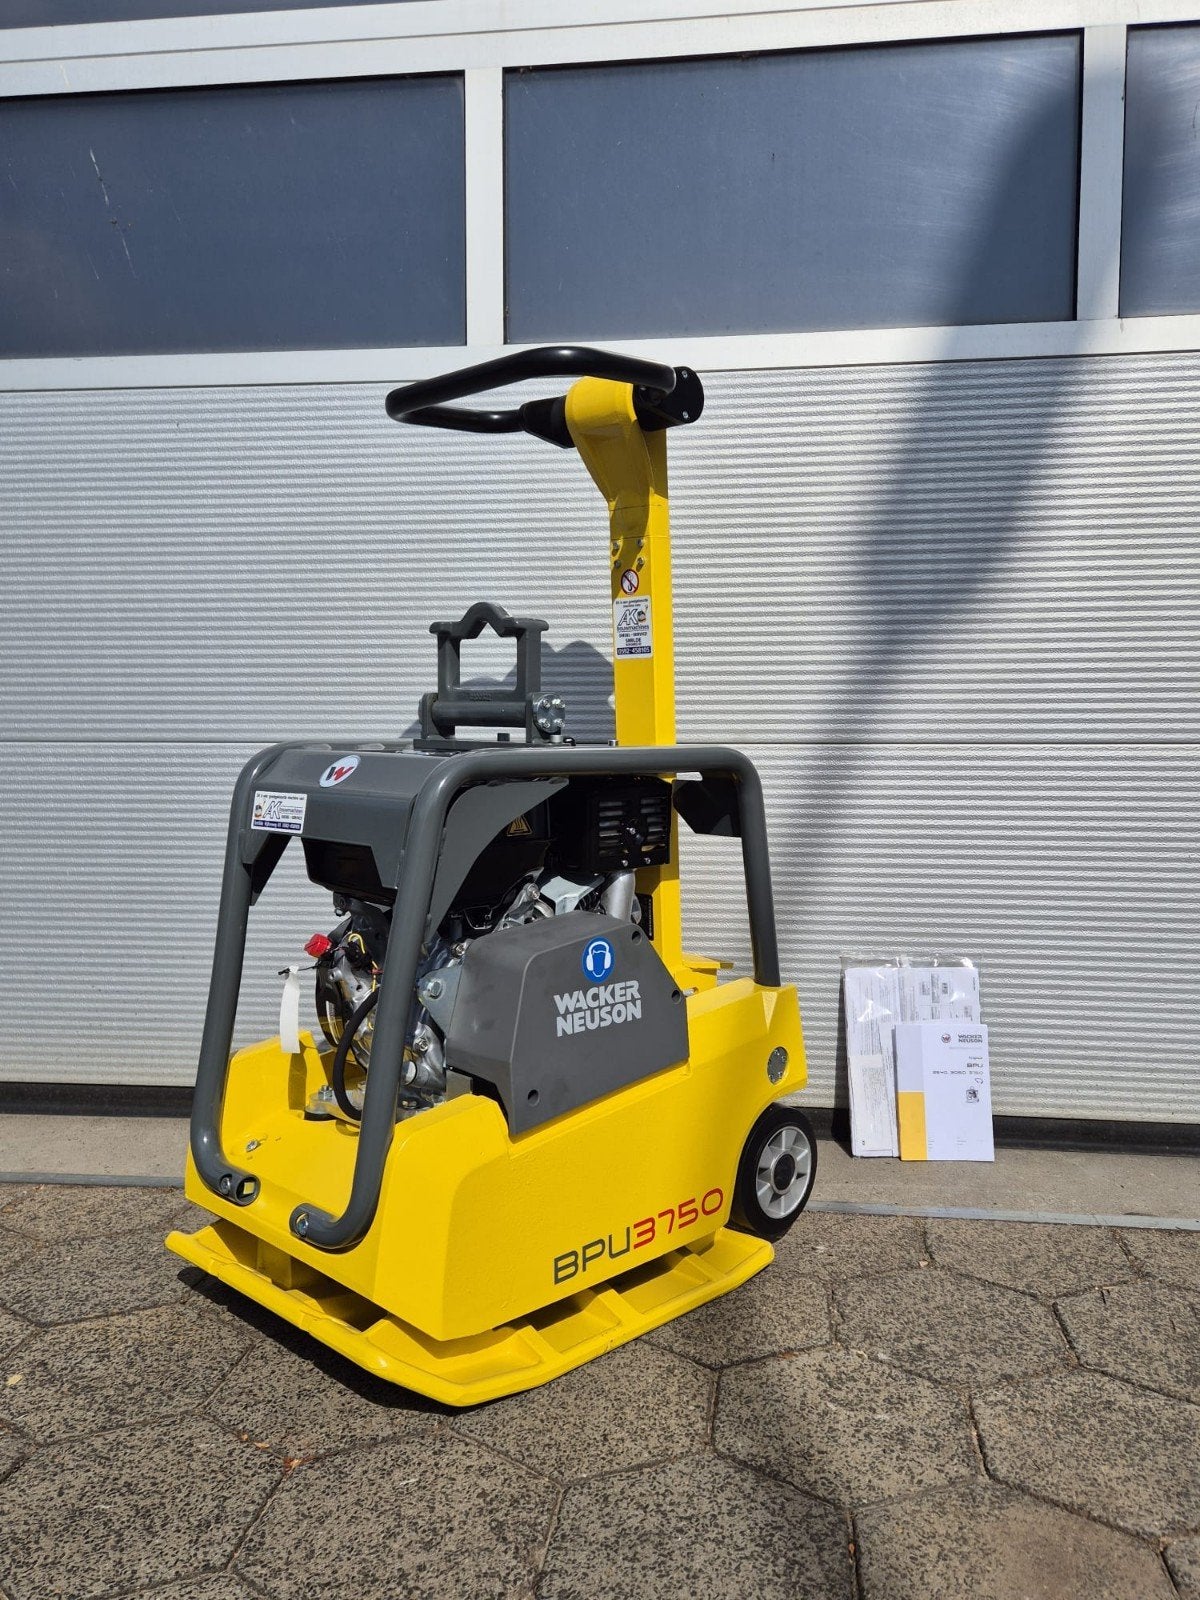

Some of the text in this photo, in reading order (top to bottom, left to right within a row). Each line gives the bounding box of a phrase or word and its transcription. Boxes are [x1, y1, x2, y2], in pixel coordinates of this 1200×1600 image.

[553, 980, 642, 1015] WACKER
[556, 999, 642, 1037] NEUSON
[553, 1187, 724, 1285] BPU3750
